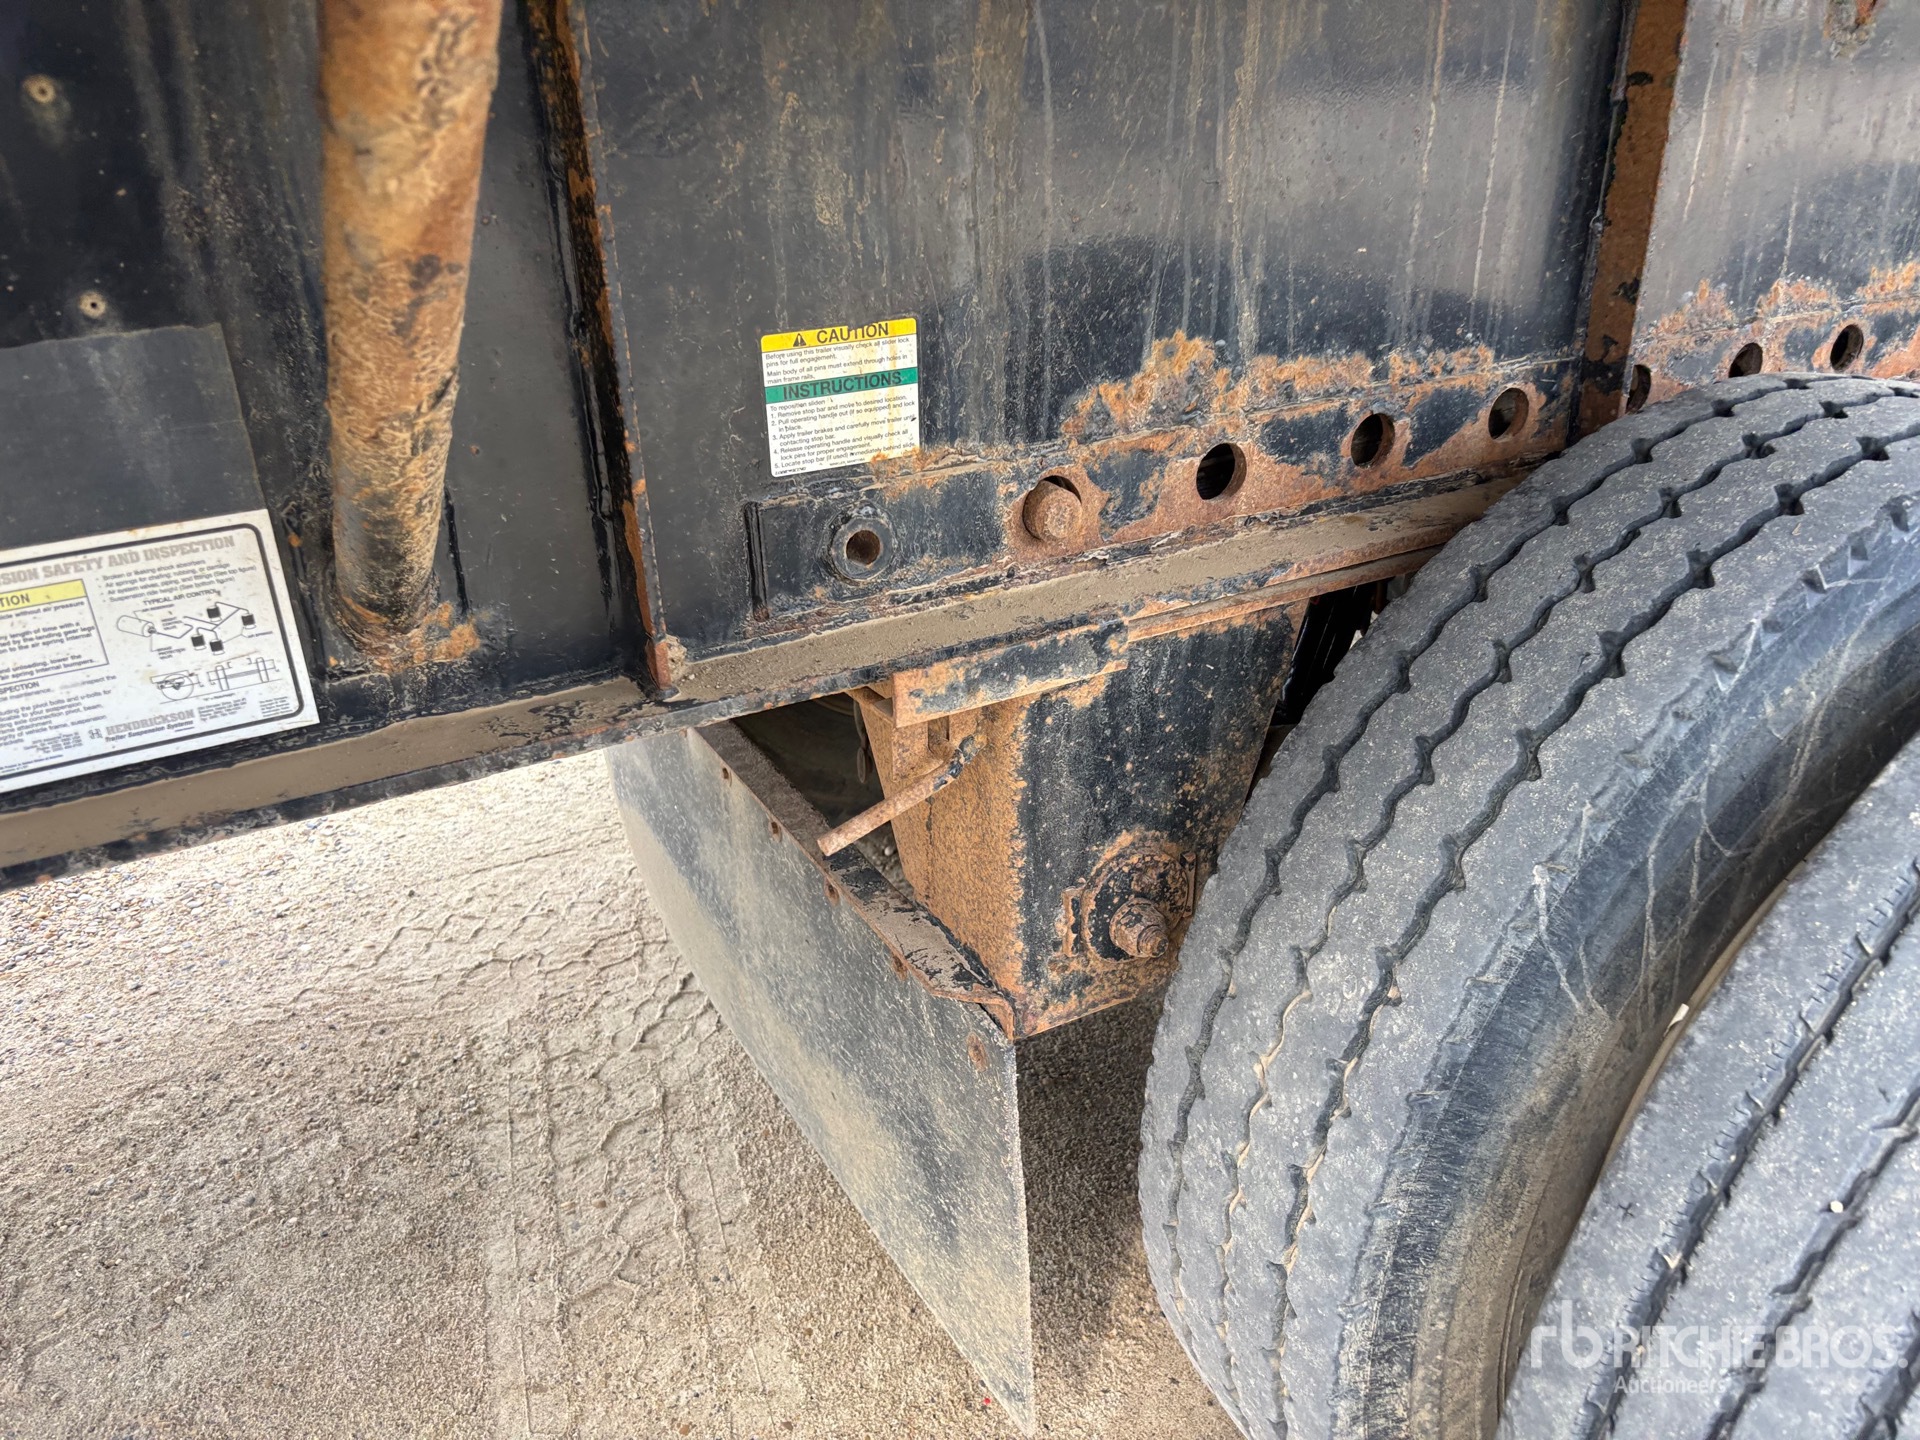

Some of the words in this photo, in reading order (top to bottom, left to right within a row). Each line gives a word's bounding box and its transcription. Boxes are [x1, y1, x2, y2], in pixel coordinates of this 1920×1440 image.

[817, 323, 888, 344] CAUTION
[766, 352, 785, 360] Before
[834, 344, 854, 352] visually
[783, 368, 797, 376] body
[864, 357, 885, 365] through
[783, 371, 902, 400] INSTRUCTIONS
[778, 410, 801, 418] Remove
[779, 402, 807, 411] reposition
[791, 415, 817, 424] operating
[819, 412, 837, 420] handle
[864, 404, 891, 414] equipped)
[779, 432, 795, 440] Apply
[847, 421, 869, 430] carefully
[780, 438, 810, 447] contacting
[780, 445, 803, 453] Release
[804, 442, 830, 451] operating
[832, 438, 850, 446] handle
[864, 433, 883, 442] visually
[781, 460, 800, 468] Locate
[42, 557, 105, 578] SAFETY
[107, 550, 141, 567] AND
[143, 535, 235, 561] INSPECTION
[102, 572, 126, 581] Broken
[156, 564, 175, 572] shock
[176, 559, 206, 569] absorbers
[115, 578, 138, 587] springs
[206, 562, 231, 571] damage
[109, 592, 146, 603] Suspension
[159, 586, 179, 595] height
[194, 579, 216, 588] bottom
[117, 585, 140, 594] system
[143, 596, 173, 606] TYPICAL
[173, 593, 185, 601] AIR
[185, 588, 217, 599] CONTROL
[0, 593, 31, 608] TION
[15, 608, 41, 617] without
[53, 601, 85, 612] pressure
[9, 630, 34, 640] length
[35, 631, 62, 641] landing
[64, 628, 79, 636] gear
[81, 625, 95, 633] legs
[42, 638, 65, 647] spring
[66, 632, 93, 642] internal
[50, 657, 69, 665] lower
[12, 670, 35, 680] spring
[35, 665, 62, 674] internal
[29, 709, 44, 717] your
[45, 701, 83, 713] suspension
[32, 702, 49, 710] pivot
[49, 698, 66, 706] bolts
[80, 691, 102, 700] u-bolts
[14, 718, 28, 726] axle
[29, 711, 64, 723] connection
[25, 727, 48, 736] vehicle
[70, 714, 107, 726] suspension
[106, 709, 195, 736] HENDRICKSON
[105, 733, 127, 743] Trailer
[127, 724, 166, 738] Suspension
[166, 719, 194, 730] Systems
